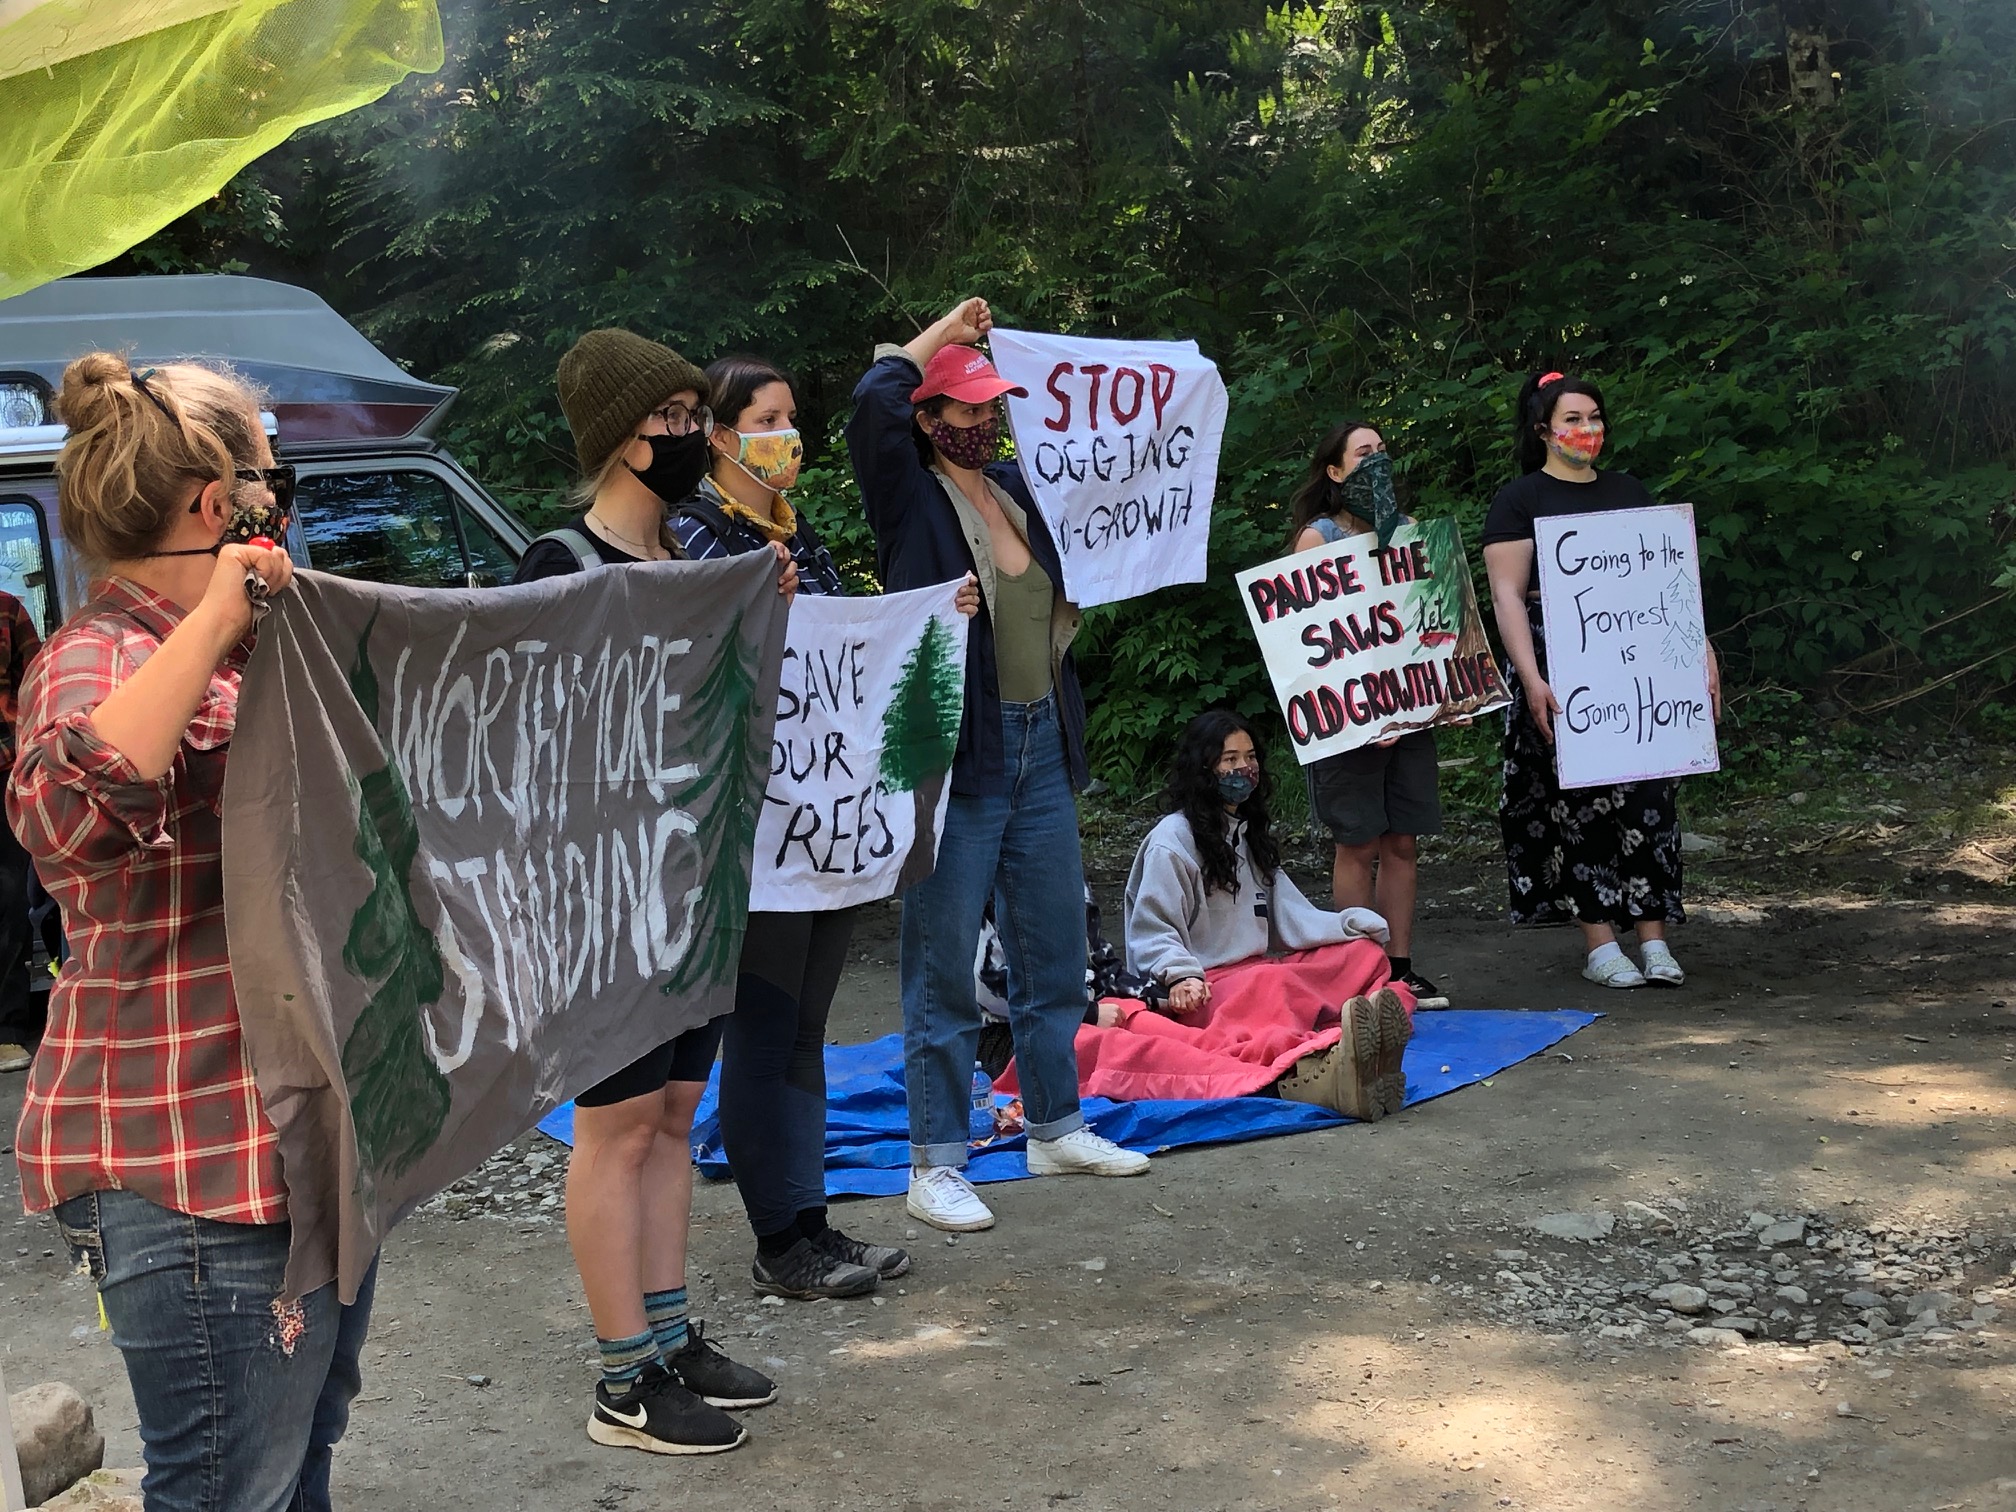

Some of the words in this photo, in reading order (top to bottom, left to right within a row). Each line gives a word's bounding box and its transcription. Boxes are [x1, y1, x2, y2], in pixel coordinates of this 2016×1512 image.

[1044, 362, 1178, 432] STOP
[1033, 425, 1194, 485] OGGING
[1050, 480, 1193, 555] D-GROWTH
[1248, 554, 1366, 624] PAUSE
[1369, 540, 1435, 586] THE
[1555, 530, 1632, 578] Going
[1638, 533, 1655, 571] to
[1661, 533, 1685, 568] the
[1301, 600, 1405, 669] SAWS
[1574, 586, 1670, 653] Forrest
[1620, 645, 1638, 665] is
[391, 620, 566, 842] WORTH
[558, 635, 700, 834] MORE
[1566, 686, 1631, 735] Going
[1634, 676, 1706, 745] Home
[424, 808, 703, 1075] STANDING
